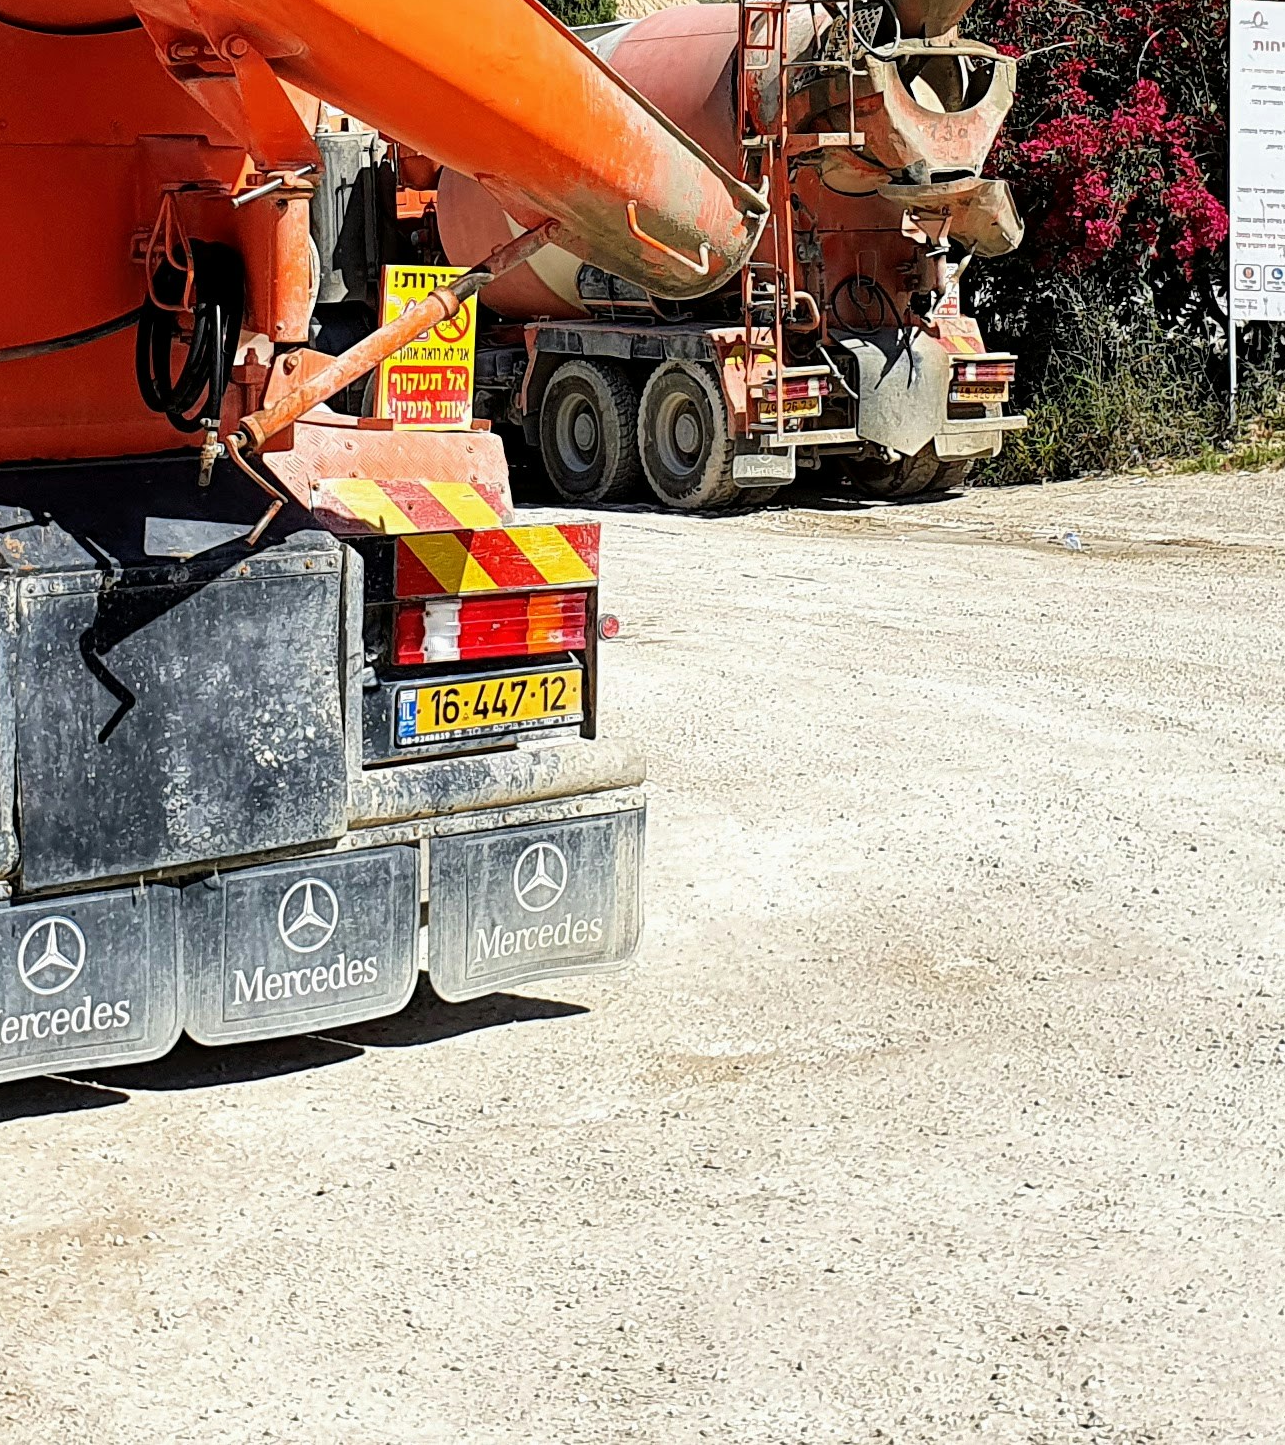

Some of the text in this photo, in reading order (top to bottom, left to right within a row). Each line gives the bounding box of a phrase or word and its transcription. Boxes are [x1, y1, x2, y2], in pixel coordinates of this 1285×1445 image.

[421, 347, 441, 361] רואה
[443, 345, 454, 361] לא
[457, 347, 470, 361] אני
[391, 369, 467, 395] אל תעקוף
[435, 400, 466, 419] אותי
[402, 703, 413, 720] IL
[476, 913, 603, 964] Mercedes
[232, 952, 379, 1006] Mercedes
